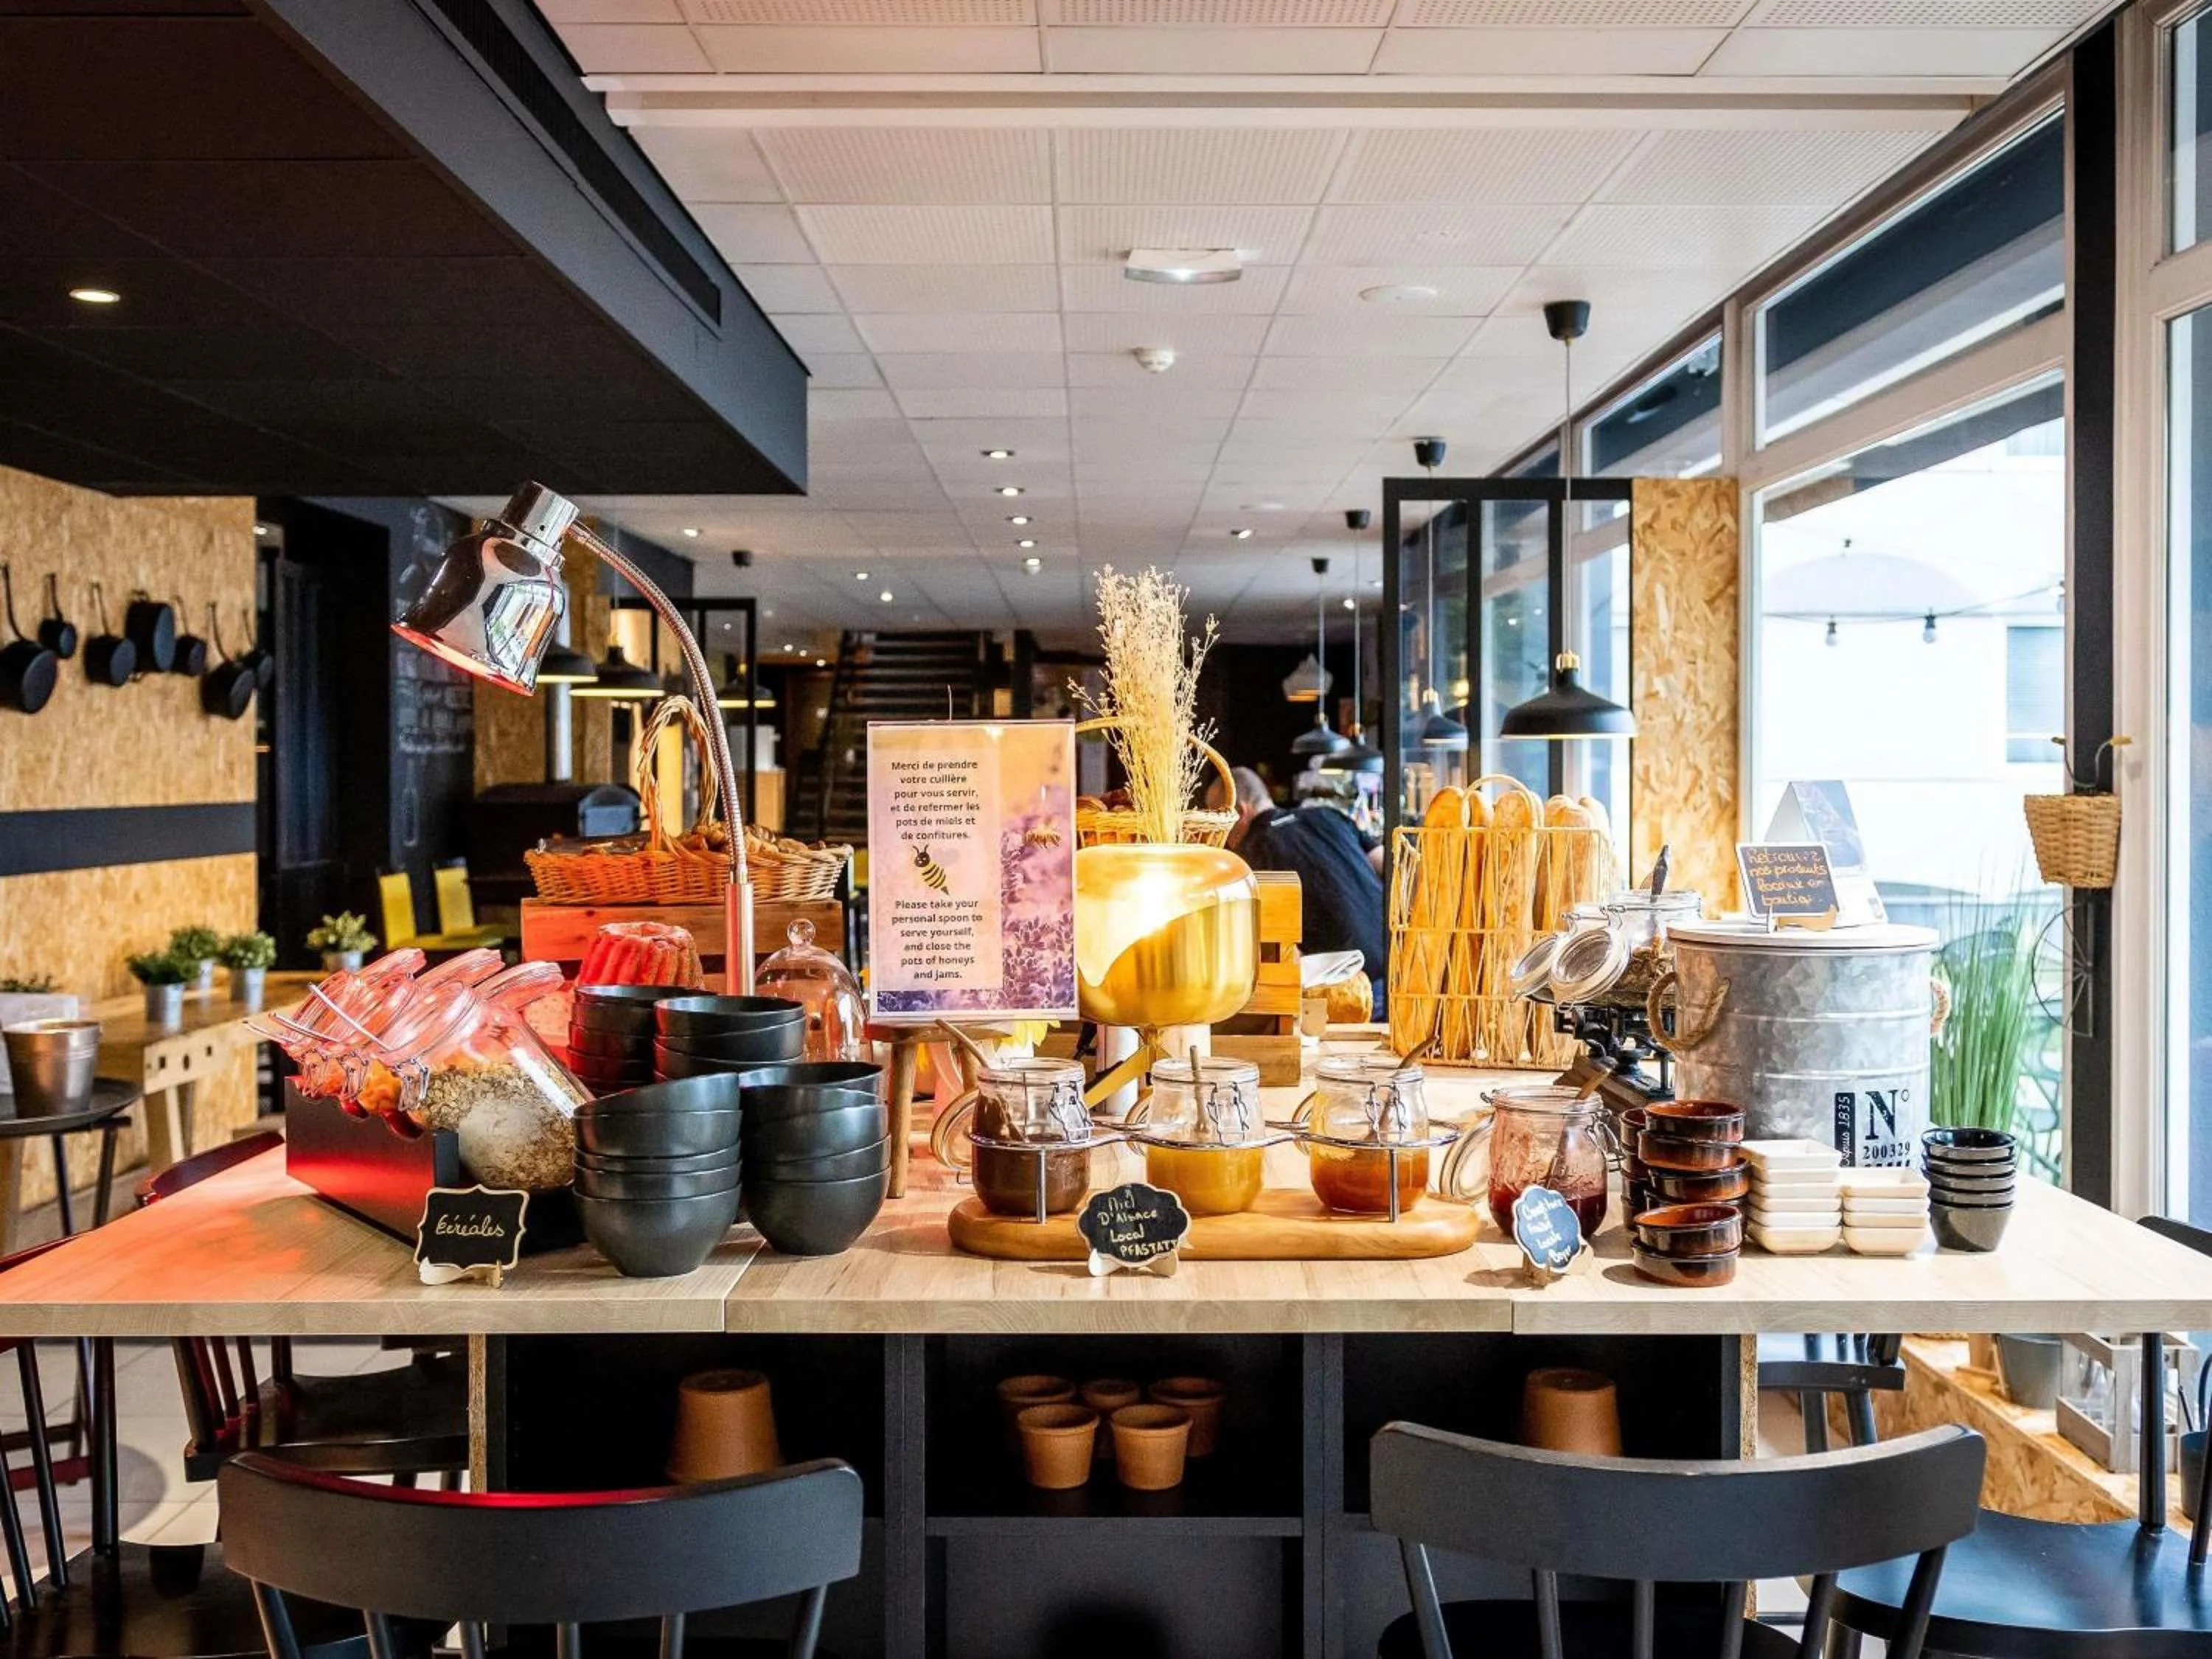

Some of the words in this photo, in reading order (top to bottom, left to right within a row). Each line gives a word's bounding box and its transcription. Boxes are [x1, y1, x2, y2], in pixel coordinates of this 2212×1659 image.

[892, 761, 919, 770] Merci
[923, 761, 934, 769] de
[938, 761, 978, 771] prendre
[930, 774, 967, 783] cuillère
[894, 790, 917, 800] pour
[918, 803, 963, 811] refermer
[967, 802, 980, 810] les
[897, 819, 917, 828] pots
[921, 817, 932, 826] de
[936, 817, 962, 825] miels
[901, 832, 913, 840] de
[916, 832, 970, 840] confitures.
[895, 900, 928, 908] Please
[930, 900, 953, 908] take
[956, 901, 978, 910] your
[892, 914, 936, 925] personal
[939, 916, 969, 924] spoon
[931, 927, 974, 939] yourself,
[904, 942, 923, 951] and
[926, 942, 951, 950] close
[954, 942, 970, 950] the
[901, 958, 922, 967] pots
[926, 956, 936, 965] of
[939, 956, 974, 966] honeys
[914, 970, 932, 979] and
[935, 970, 961, 981] jams.
[1838, 1096, 1850, 1128] 1835
[1863, 1141, 1910, 1160] 200329
